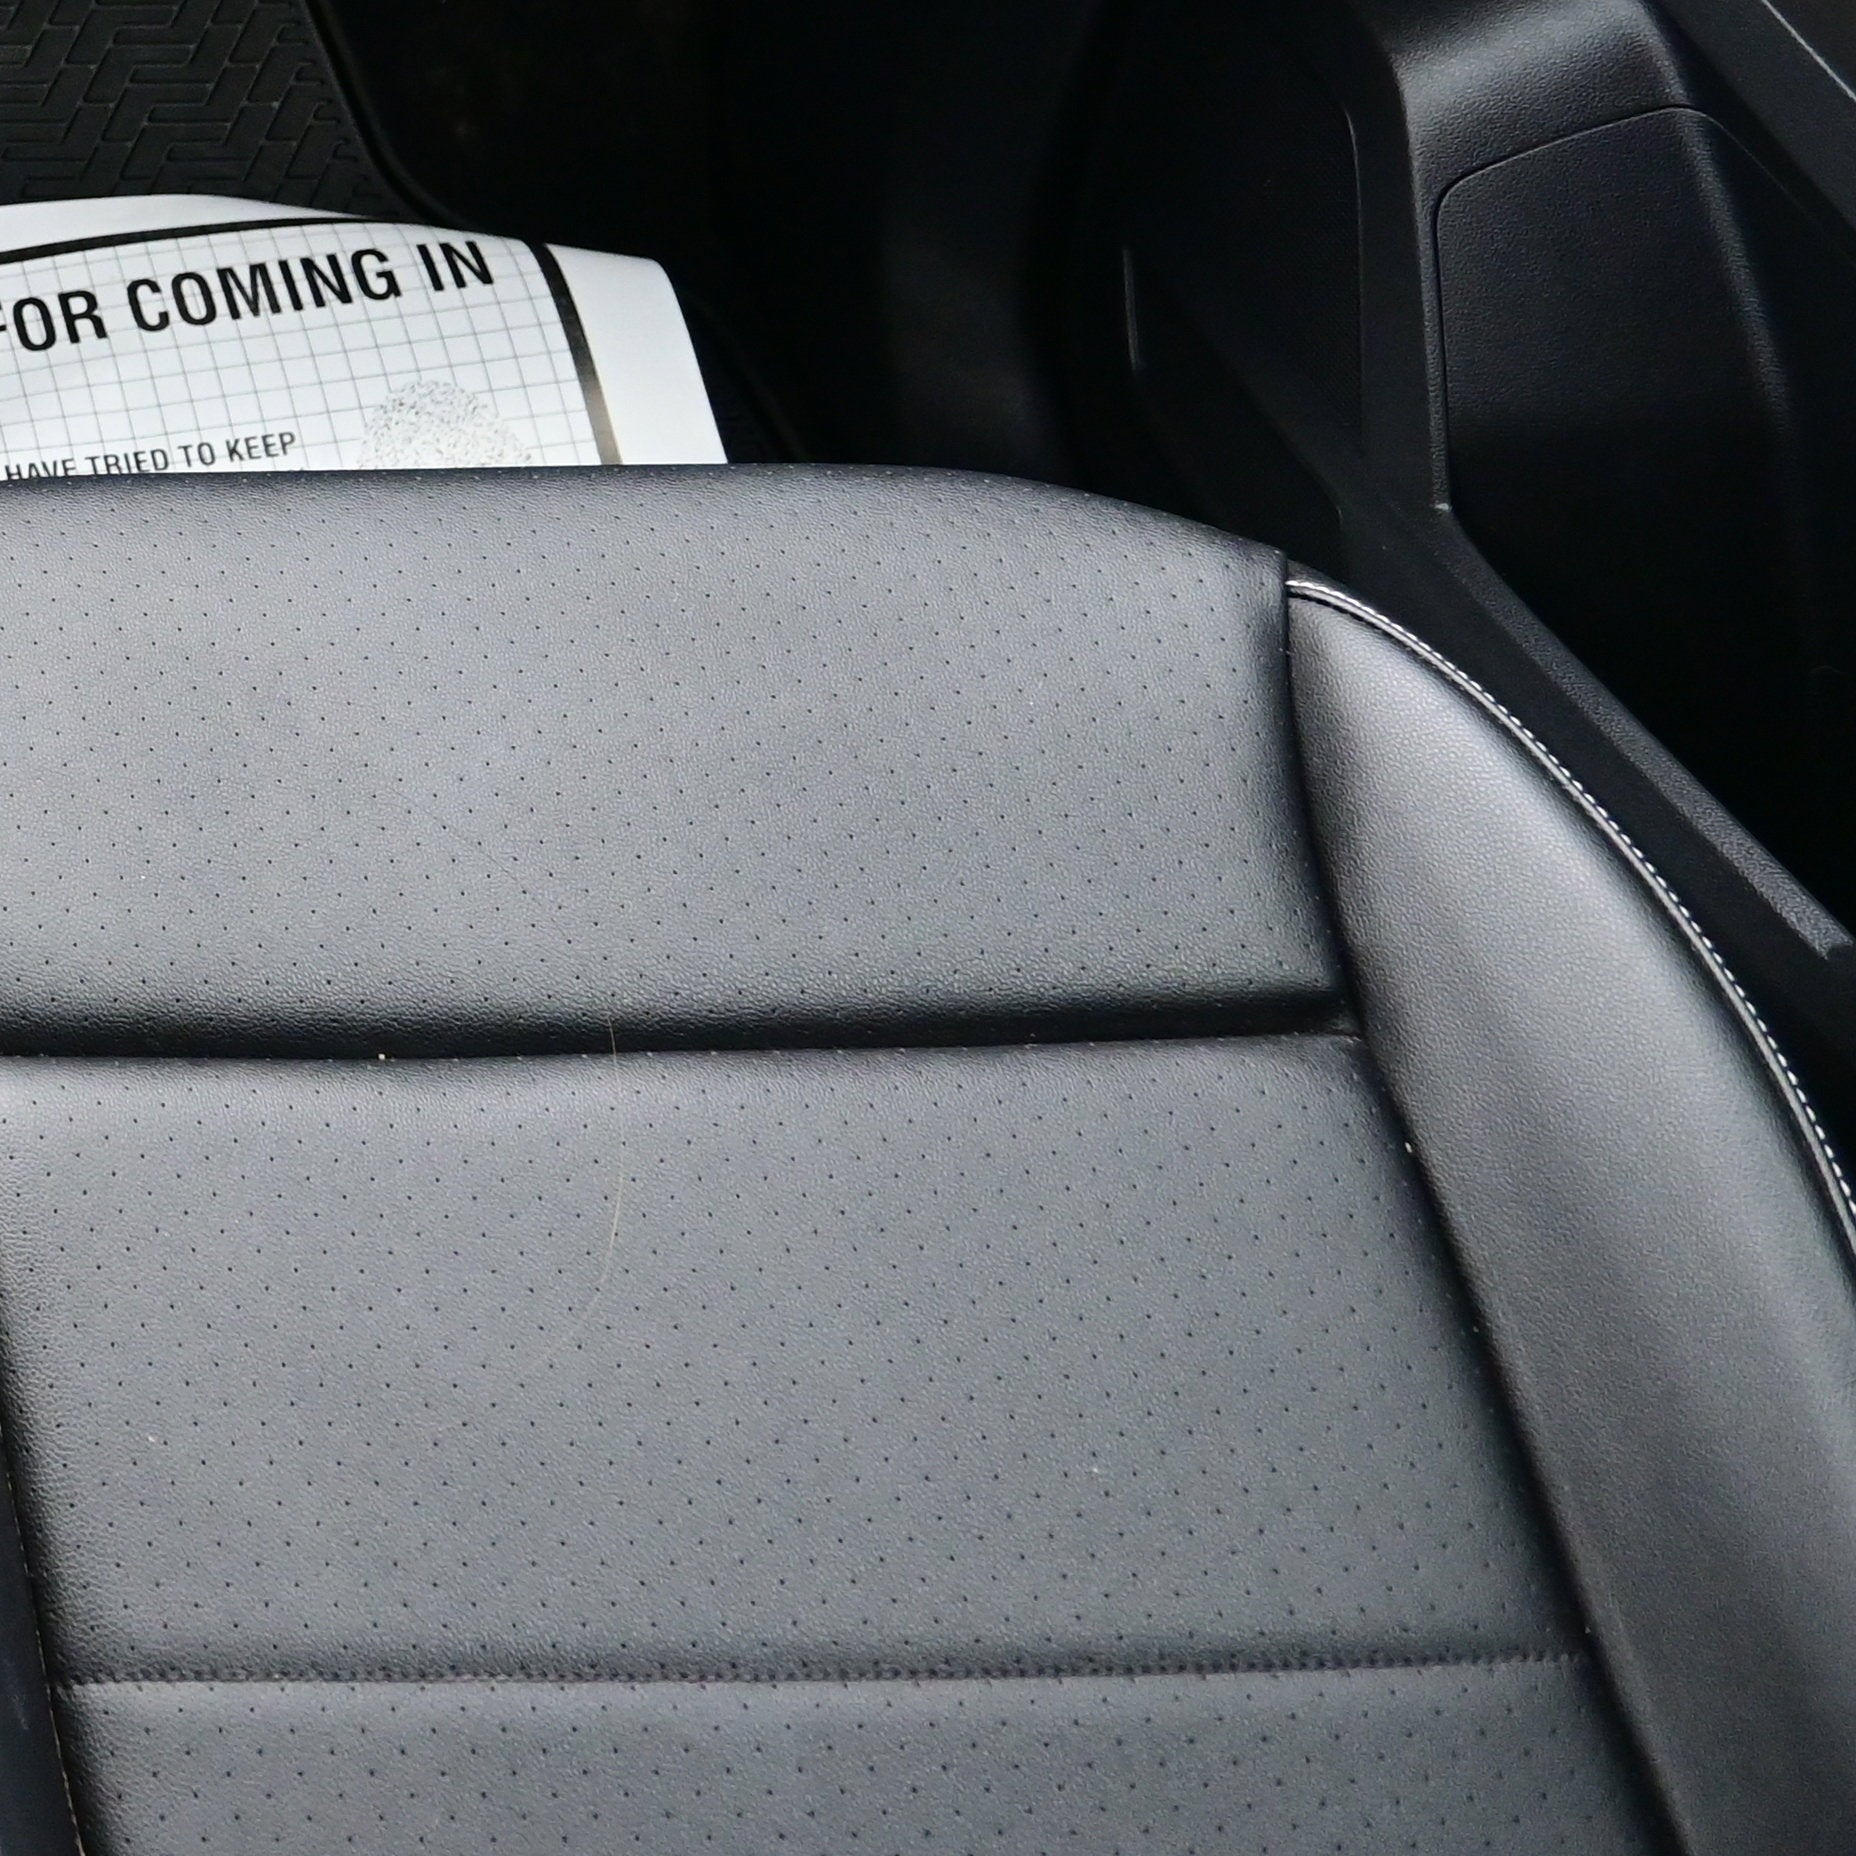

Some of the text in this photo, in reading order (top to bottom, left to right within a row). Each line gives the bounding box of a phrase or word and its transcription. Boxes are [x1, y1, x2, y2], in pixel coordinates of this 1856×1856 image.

[126, 248, 401, 332] COMING
[416, 240, 494, 292] IN
[84, 448, 169, 476] TRIED
[178, 441, 216, 467] TO
[225, 431, 296, 463] KEEP
